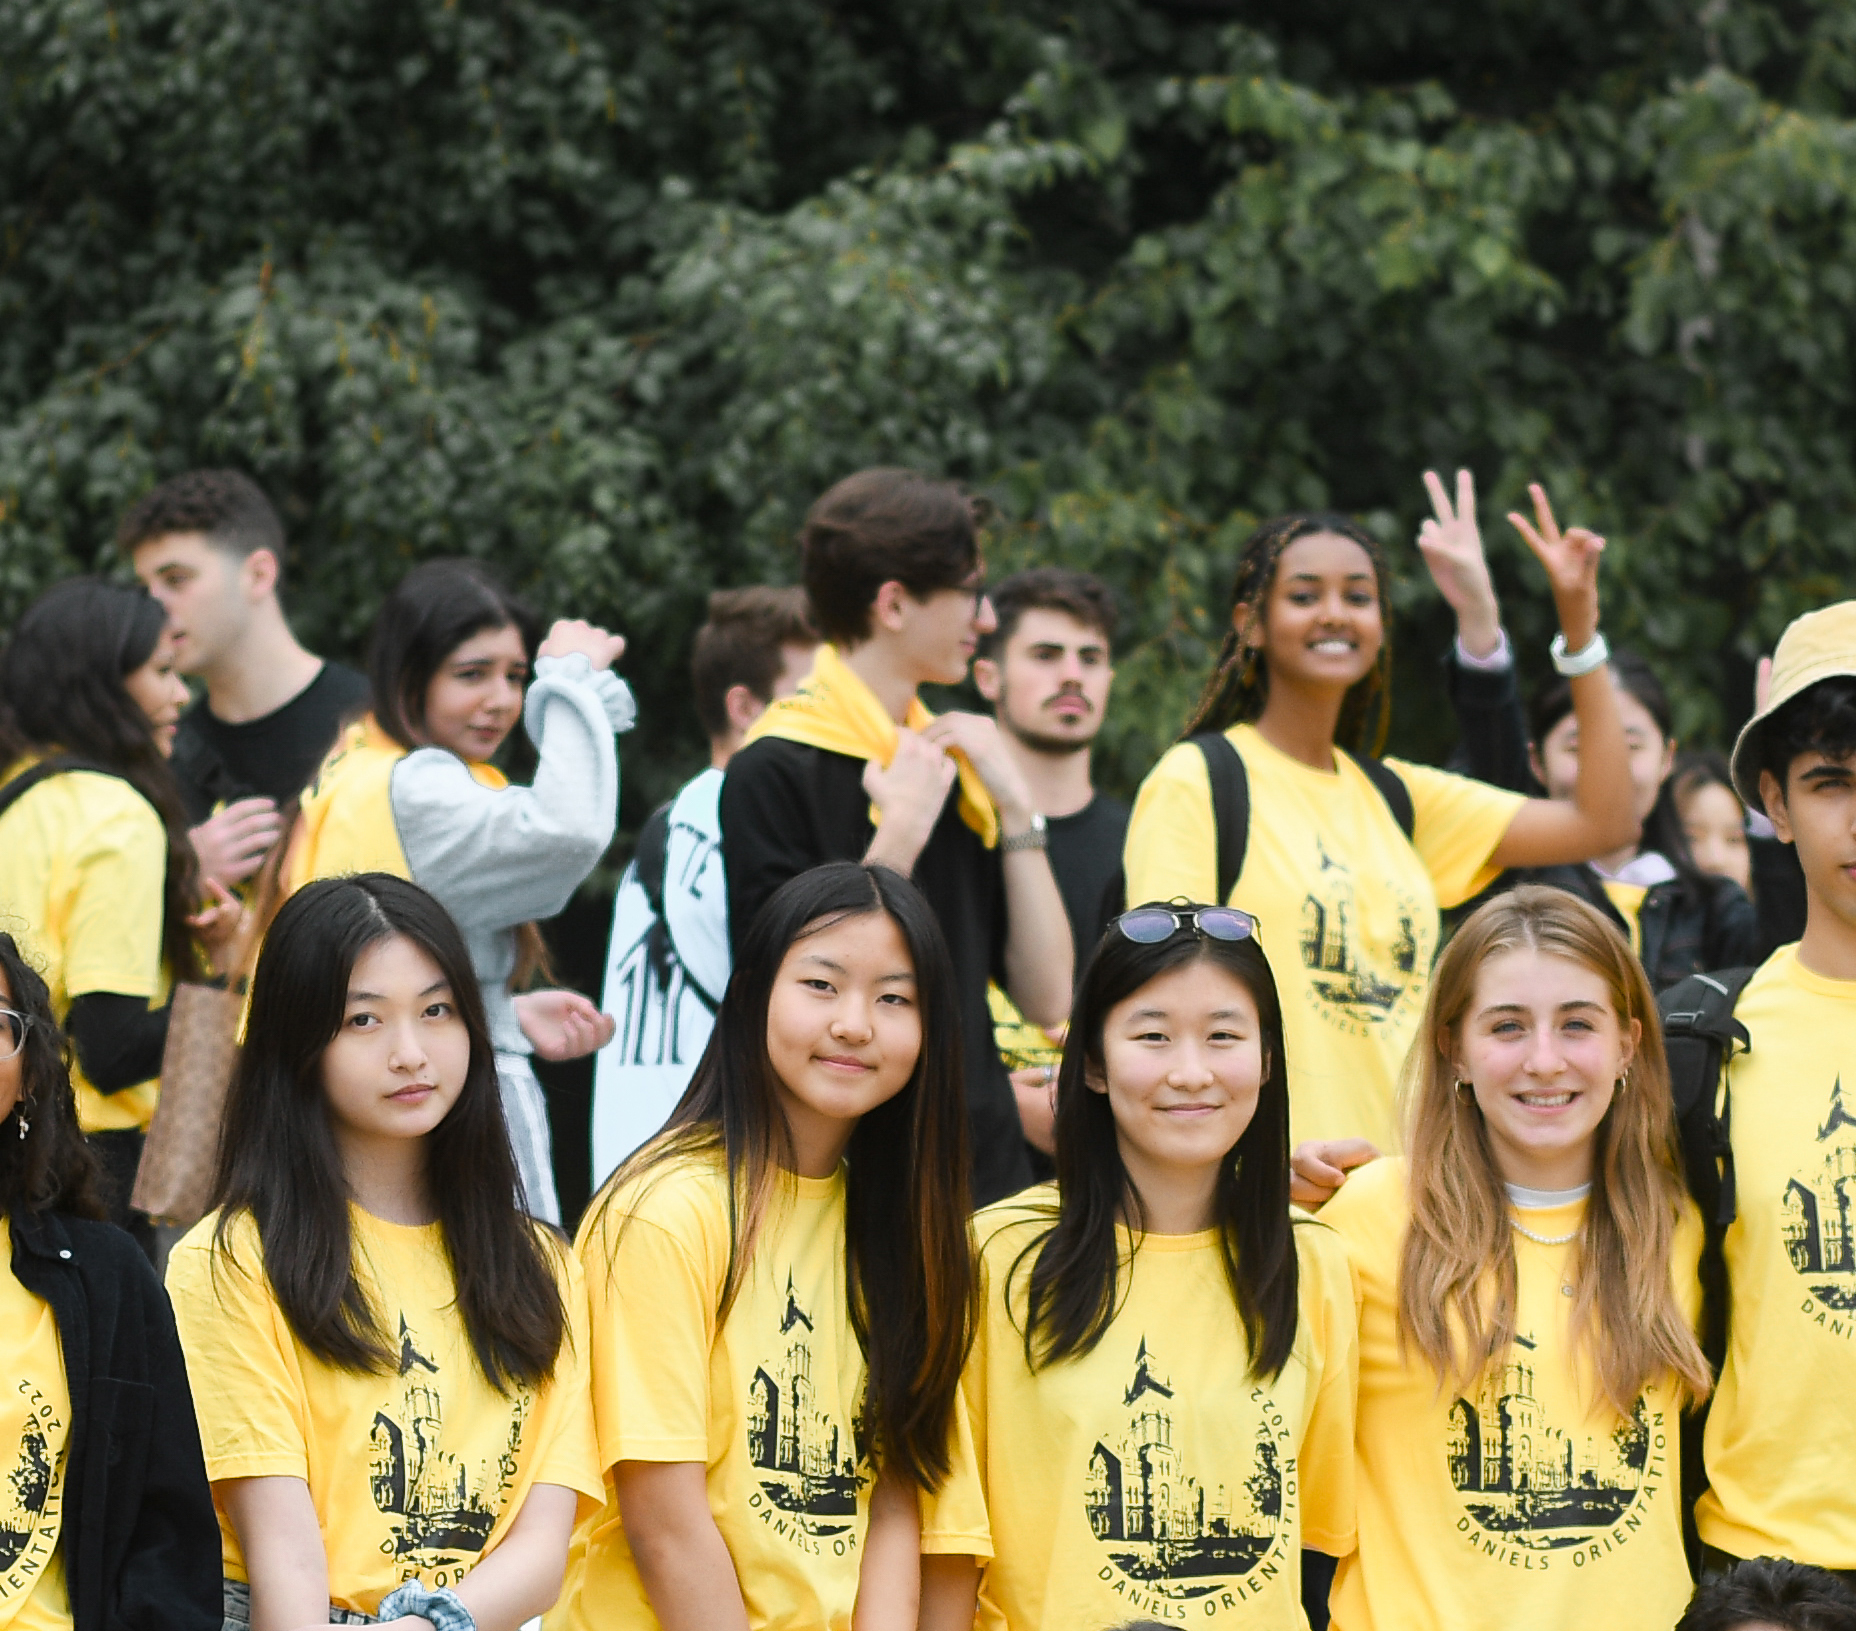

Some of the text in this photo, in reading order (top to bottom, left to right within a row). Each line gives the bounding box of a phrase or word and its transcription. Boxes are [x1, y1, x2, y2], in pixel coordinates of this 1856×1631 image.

[19, 1379, 61, 1433] 2022
[748, 1492, 820, 1556] DANIELS
[1097, 1387, 1296, 1619] DANIELS ORIENTATION 2022
[1456, 1412, 1666, 1570] DANIELS ORIENTATION
